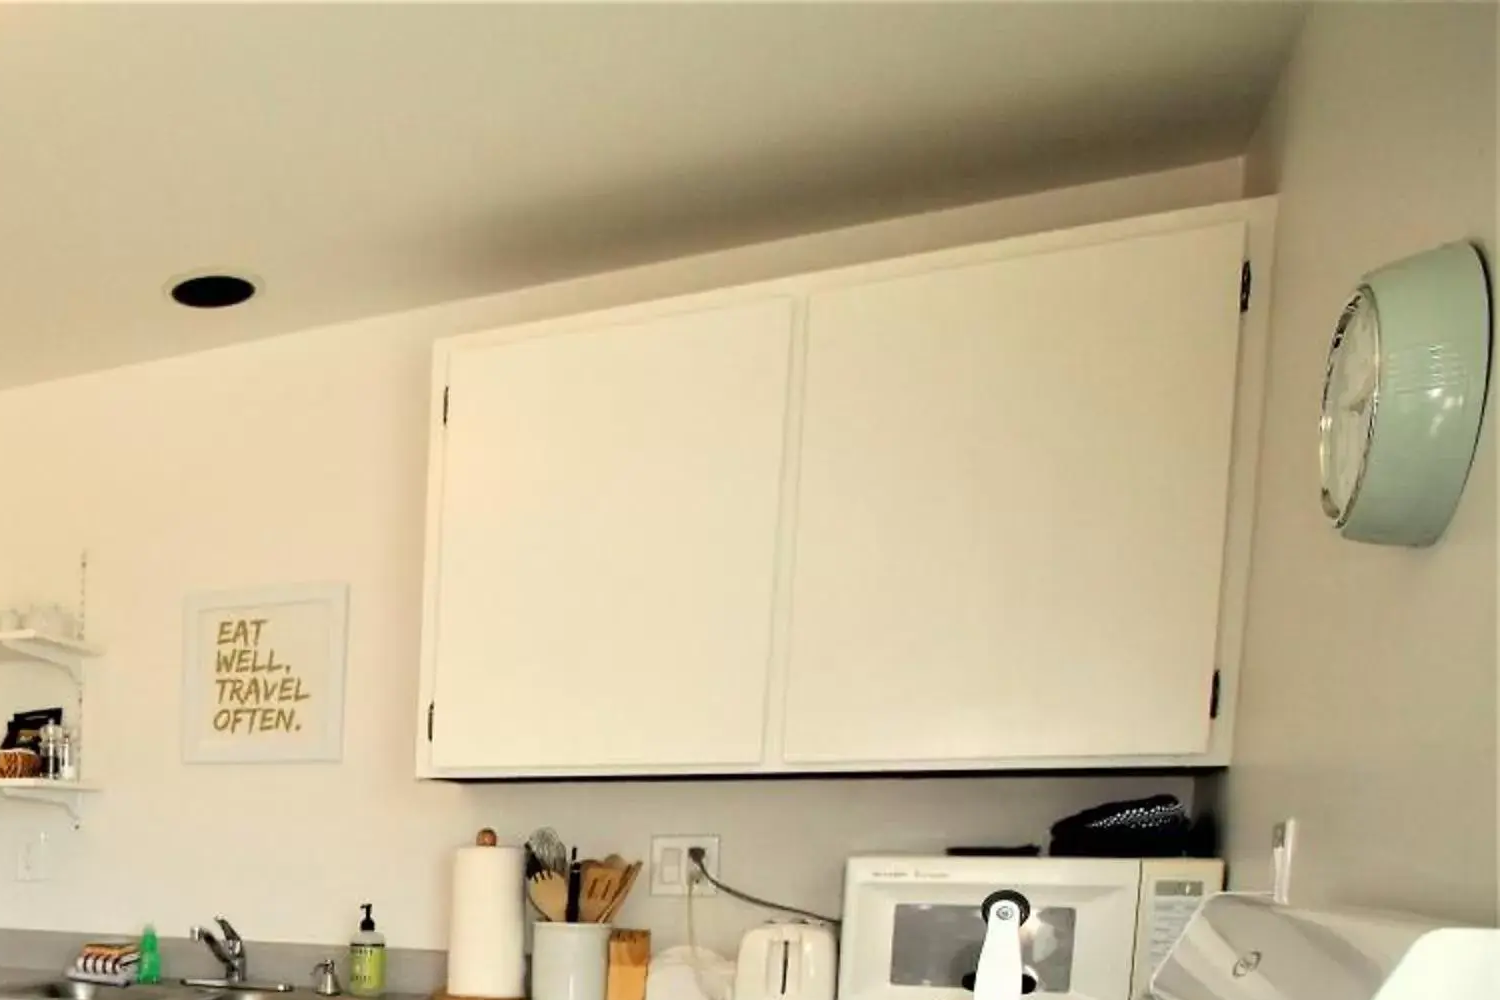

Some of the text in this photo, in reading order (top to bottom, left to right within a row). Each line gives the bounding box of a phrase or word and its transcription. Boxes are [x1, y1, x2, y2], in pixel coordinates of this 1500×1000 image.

[217, 620, 268, 647] EAT
[215, 677, 311, 705] TRAVEL
[213, 708, 302, 735] OFTEN.
